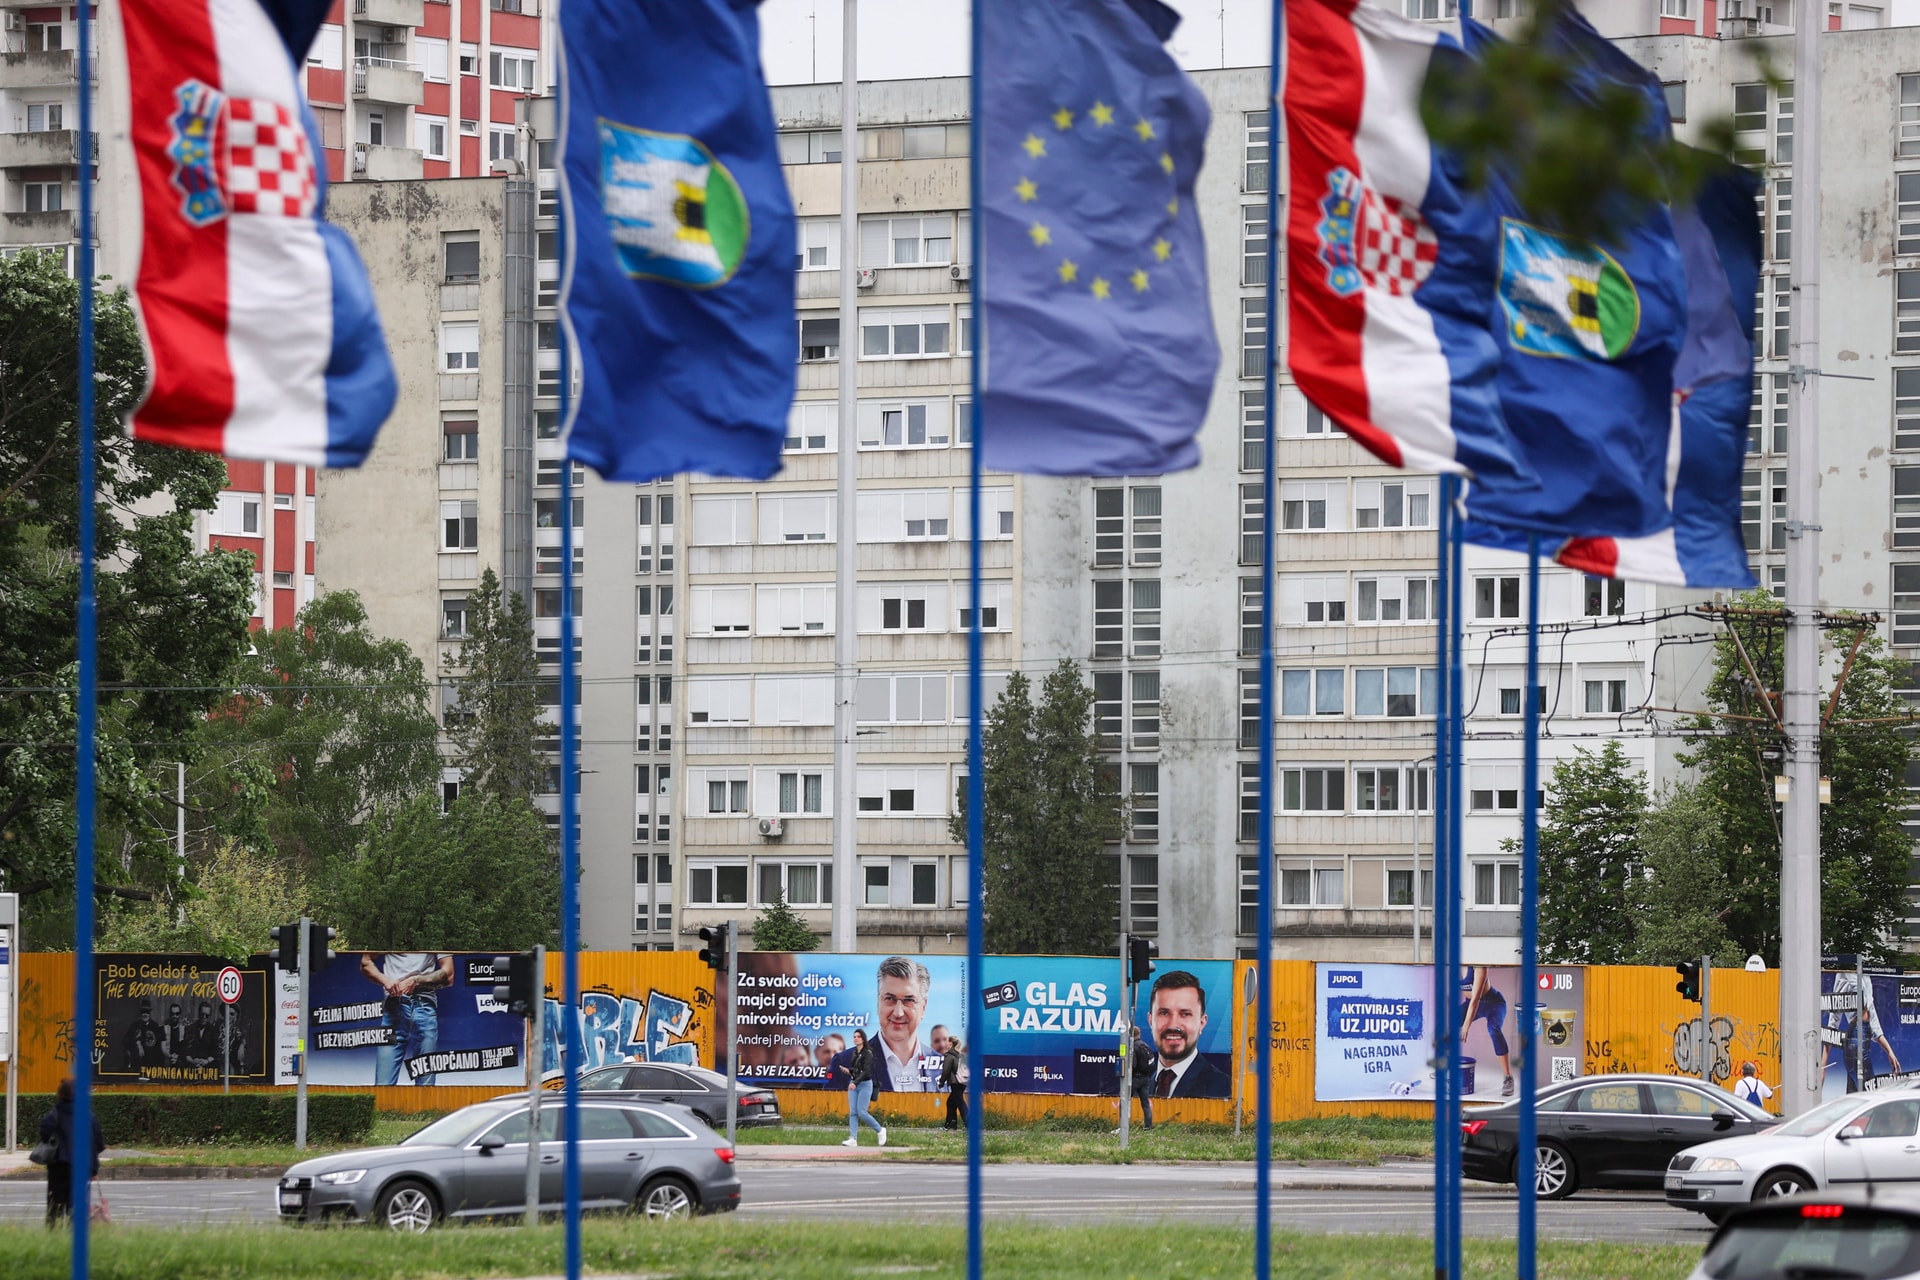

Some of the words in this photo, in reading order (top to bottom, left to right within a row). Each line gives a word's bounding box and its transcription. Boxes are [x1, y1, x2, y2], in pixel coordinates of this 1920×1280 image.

[108, 964, 136, 978] Bob
[140, 964, 187, 979] Geldof
[190, 966, 199, 979] &
[469, 963, 496, 976] Europ
[223, 976, 237, 994] 60
[737, 972, 755, 987] Za
[758, 973, 799, 988] svako
[802, 973, 845, 991] dijete,
[1332, 975, 1358, 984] JUPOL
[1553, 974, 1573, 990] JUB
[104, 979, 124, 999] THE
[128, 981, 189, 998] BOOMTOWN
[191, 981, 217, 998] RATS
[1003, 987, 1014, 999] 2
[1025, 981, 1107, 1007] GLAS
[737, 993, 775, 1010] majci
[778, 992, 827, 1011] godina
[343, 1002, 383, 1021] MODERNE
[1340, 1003, 1395, 1015] AKTIVIRAJ
[1396, 1004, 1409, 1015] SE
[736, 1011, 821, 1030] mirovinskog
[825, 1011, 870, 1027] staža!
[1340, 1018, 1360, 1032] UZ
[1363, 1019, 1409, 1033] JUPOL
[95, 1028, 109, 1037] 26.
[94, 1039, 109, 1048] 04.
[318, 1034, 322, 1048] I
[736, 1034, 772, 1047] Andrej
[773, 1034, 825, 1046] Plenković
[496, 1046, 514, 1057] JEANS
[1343, 1044, 1408, 1060] NAGRADNA
[410, 1056, 430, 1077] SVE
[430, 1050, 479, 1072] KOPČAMO
[483, 1057, 503, 1069] EXPERT
[1080, 1054, 1106, 1063] Davor
[737, 1065, 752, 1076] ZA
[755, 1065, 777, 1077] SVE
[984, 1068, 1018, 1078] FOKUS
[1364, 1061, 1392, 1073] IGRA
